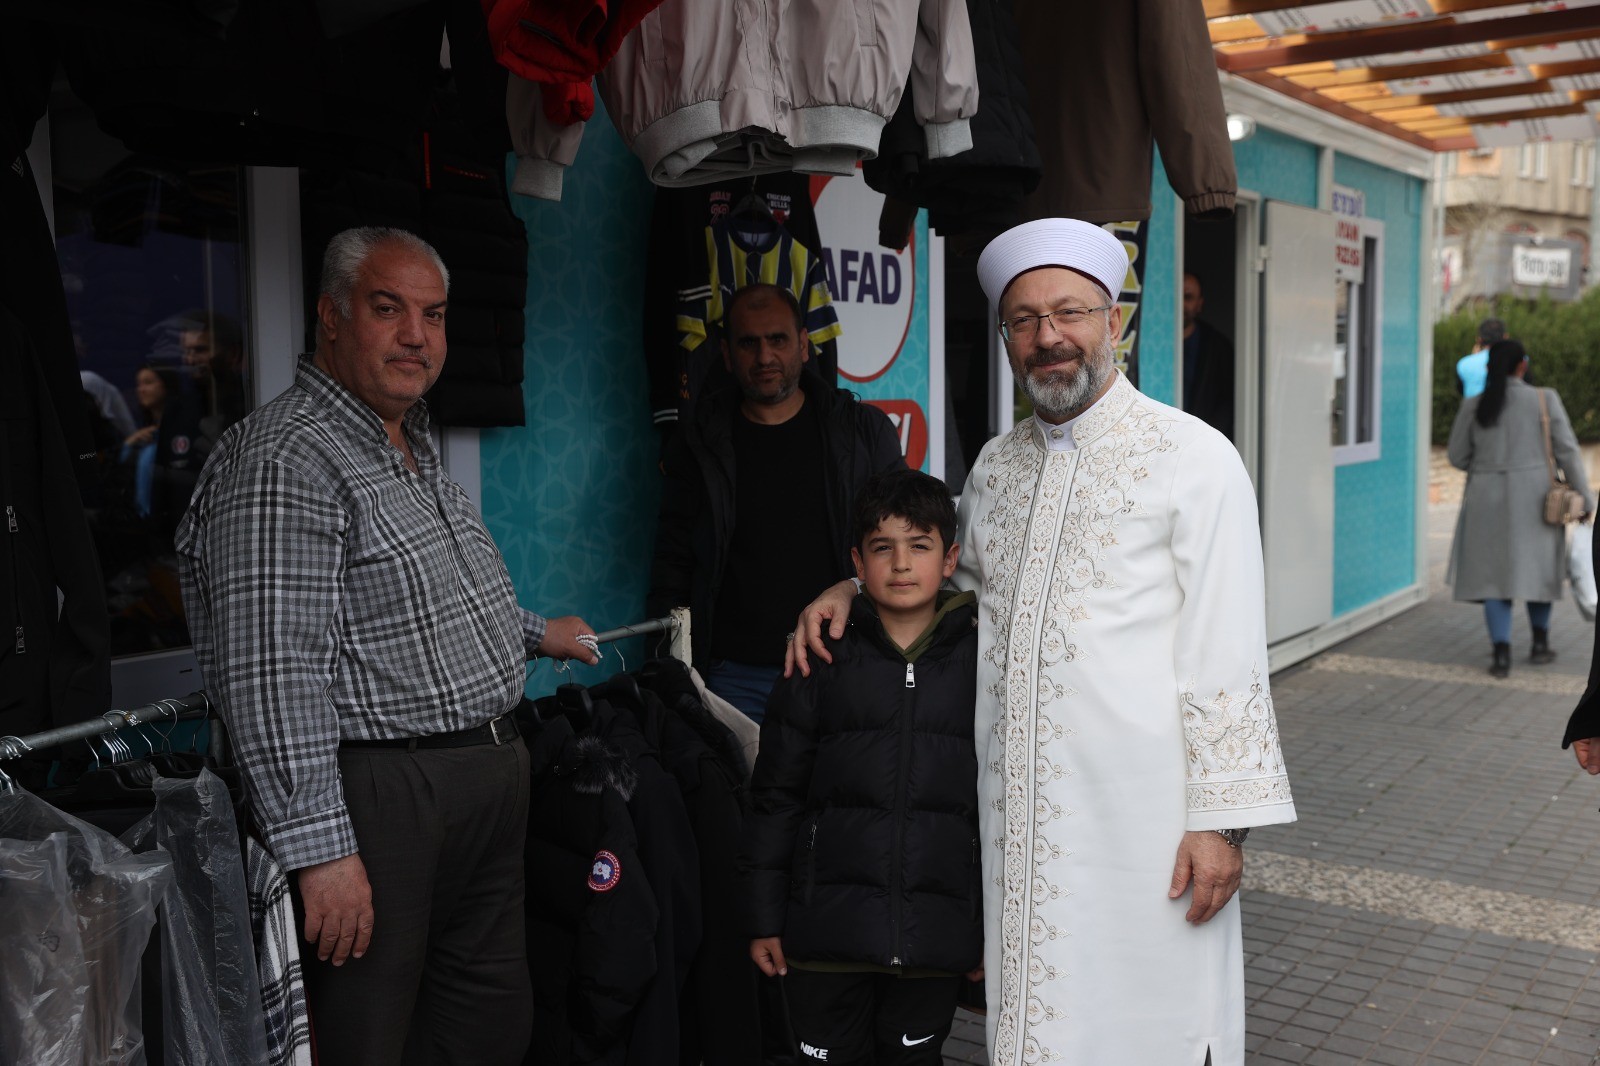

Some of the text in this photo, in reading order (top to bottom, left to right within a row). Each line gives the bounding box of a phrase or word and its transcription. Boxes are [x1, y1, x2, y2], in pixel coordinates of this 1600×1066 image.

[766, 192, 791, 202] CHICAGO
[770, 200, 788, 208] BULLS
[822, 248, 901, 305] AFAD
[800, 1041, 828, 1060] NIKE
